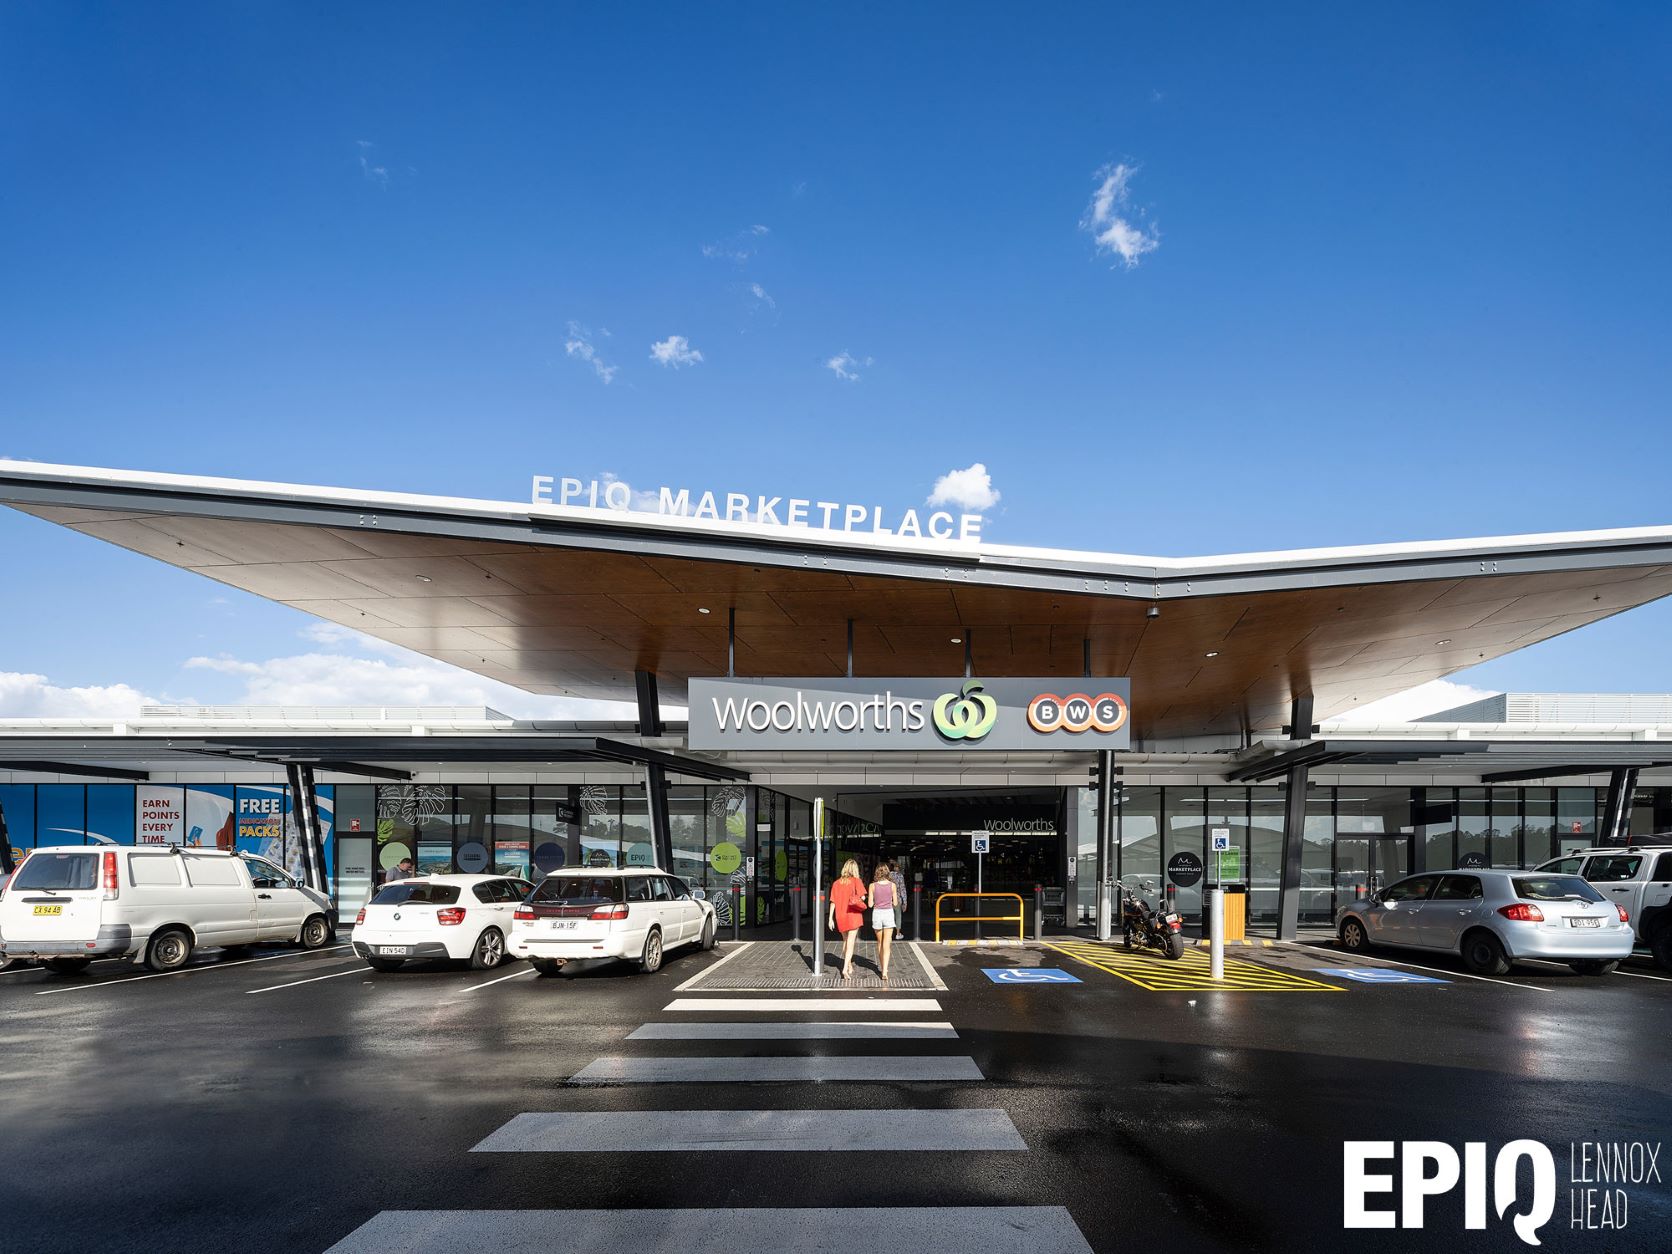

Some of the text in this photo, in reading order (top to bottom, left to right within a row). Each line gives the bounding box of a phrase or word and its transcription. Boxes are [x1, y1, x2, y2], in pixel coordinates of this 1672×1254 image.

[531, 474, 983, 543] EPIQ MARKETPLACE
[712, 691, 926, 731] Woolworths
[142, 800, 170, 808] EARN
[239, 798, 280, 814] FREE
[142, 811, 180, 820] POINTS
[142, 823, 174, 831] EVERY
[983, 817, 1054, 831] Woolworths
[239, 825, 281, 838] PACKS
[142, 835, 165, 844] TIME
[630, 854, 646, 862] EPIQ
